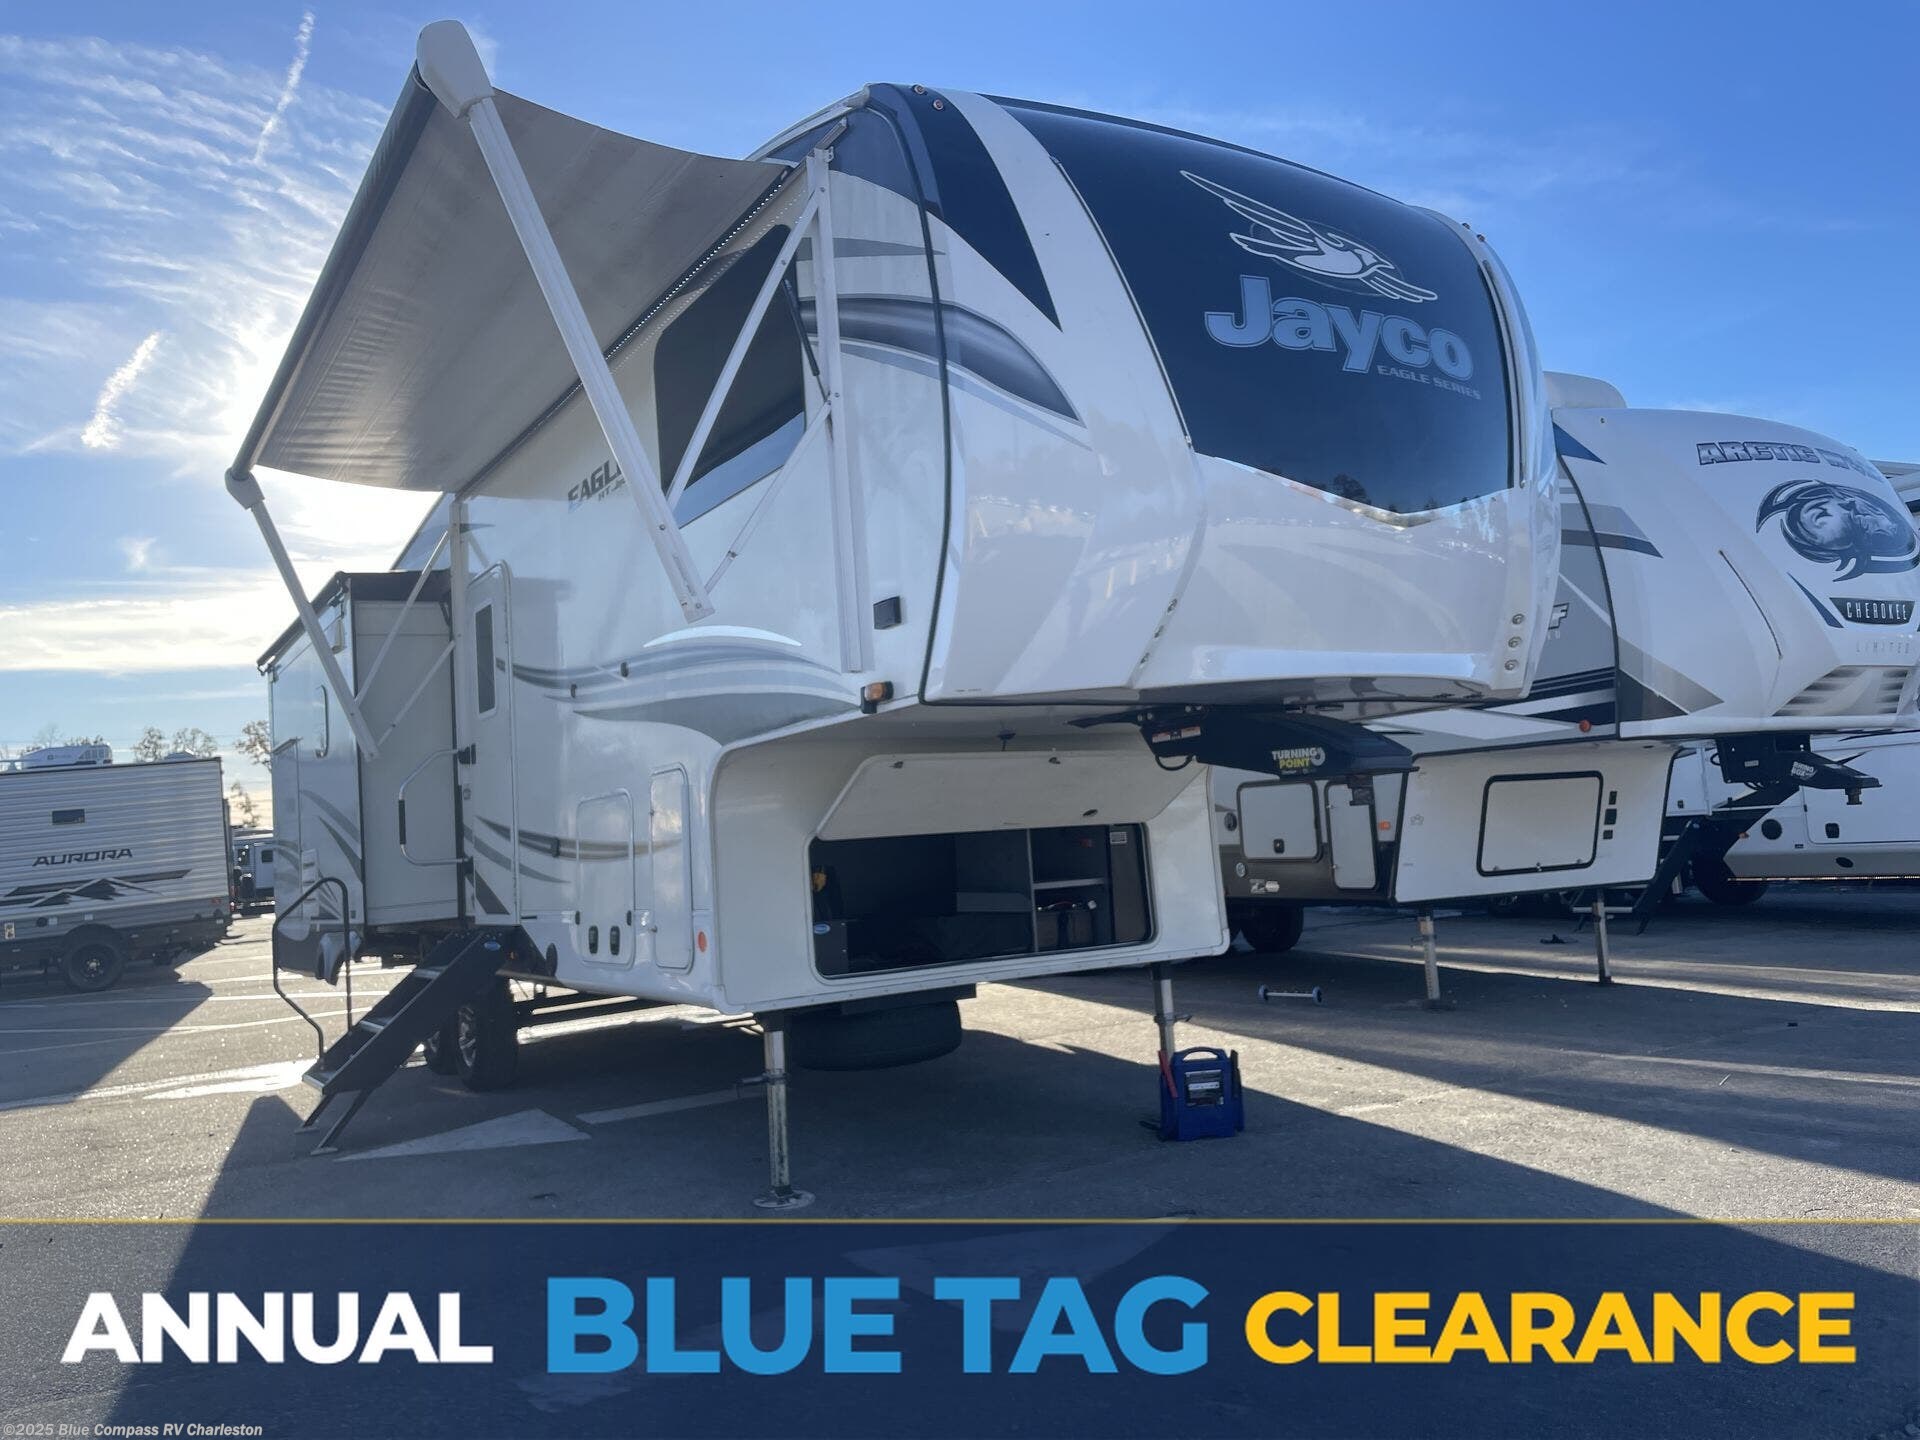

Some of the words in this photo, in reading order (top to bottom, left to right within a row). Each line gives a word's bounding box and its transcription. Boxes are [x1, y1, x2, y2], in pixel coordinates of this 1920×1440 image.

[1204, 274, 1474, 381] Jayco
[1376, 365, 1431, 385] EAGLE
[1433, 377, 1481, 400] SERIES
[1696, 441, 1821, 466] ARCTIC
[1846, 602, 1907, 620] CHEROKEE
[1271, 747, 1318, 761] TURNING
[1279, 757, 1311, 769] POINT
[32, 848, 133, 867] AURORA
